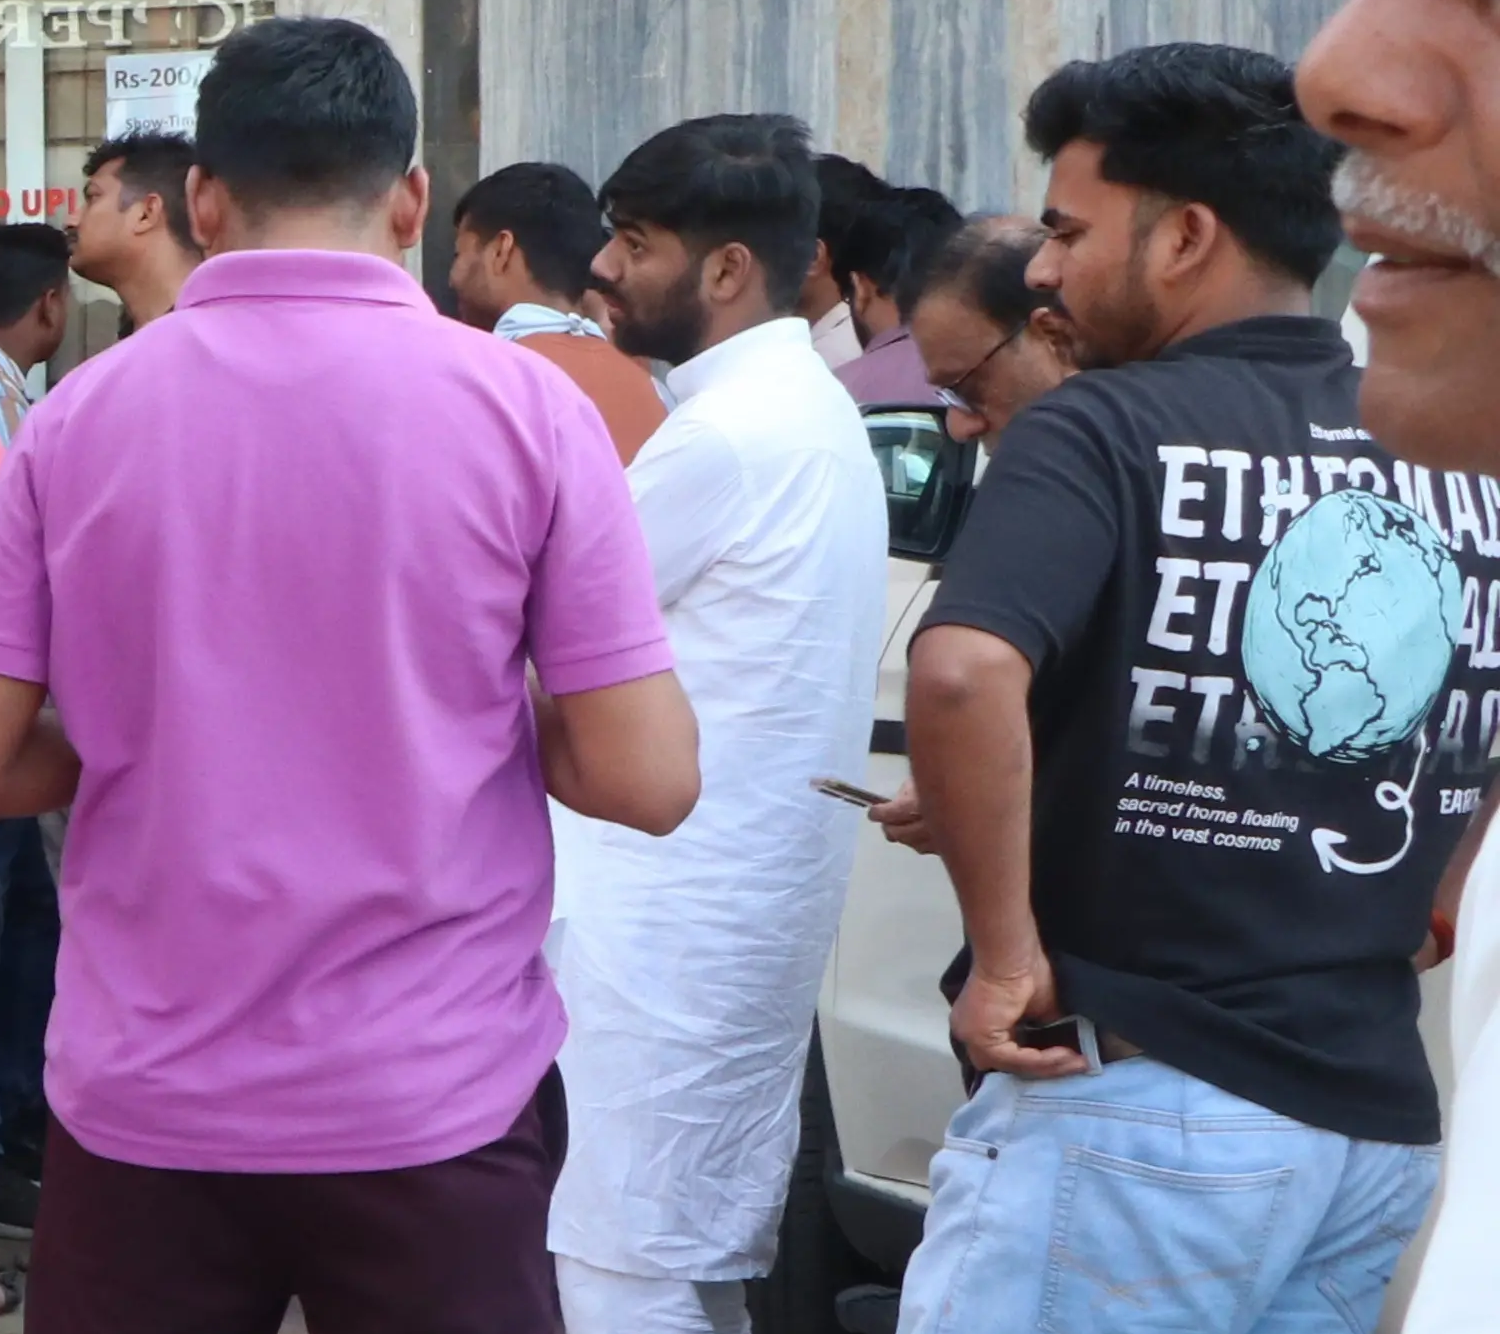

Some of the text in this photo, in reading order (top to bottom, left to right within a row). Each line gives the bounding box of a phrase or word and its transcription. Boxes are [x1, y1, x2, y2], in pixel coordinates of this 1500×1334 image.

[1124, 772, 1227, 802] A timeless,
[1117, 796, 1300, 833] sacred home floating
[1114, 817, 1282, 852] in the vast cosmos
